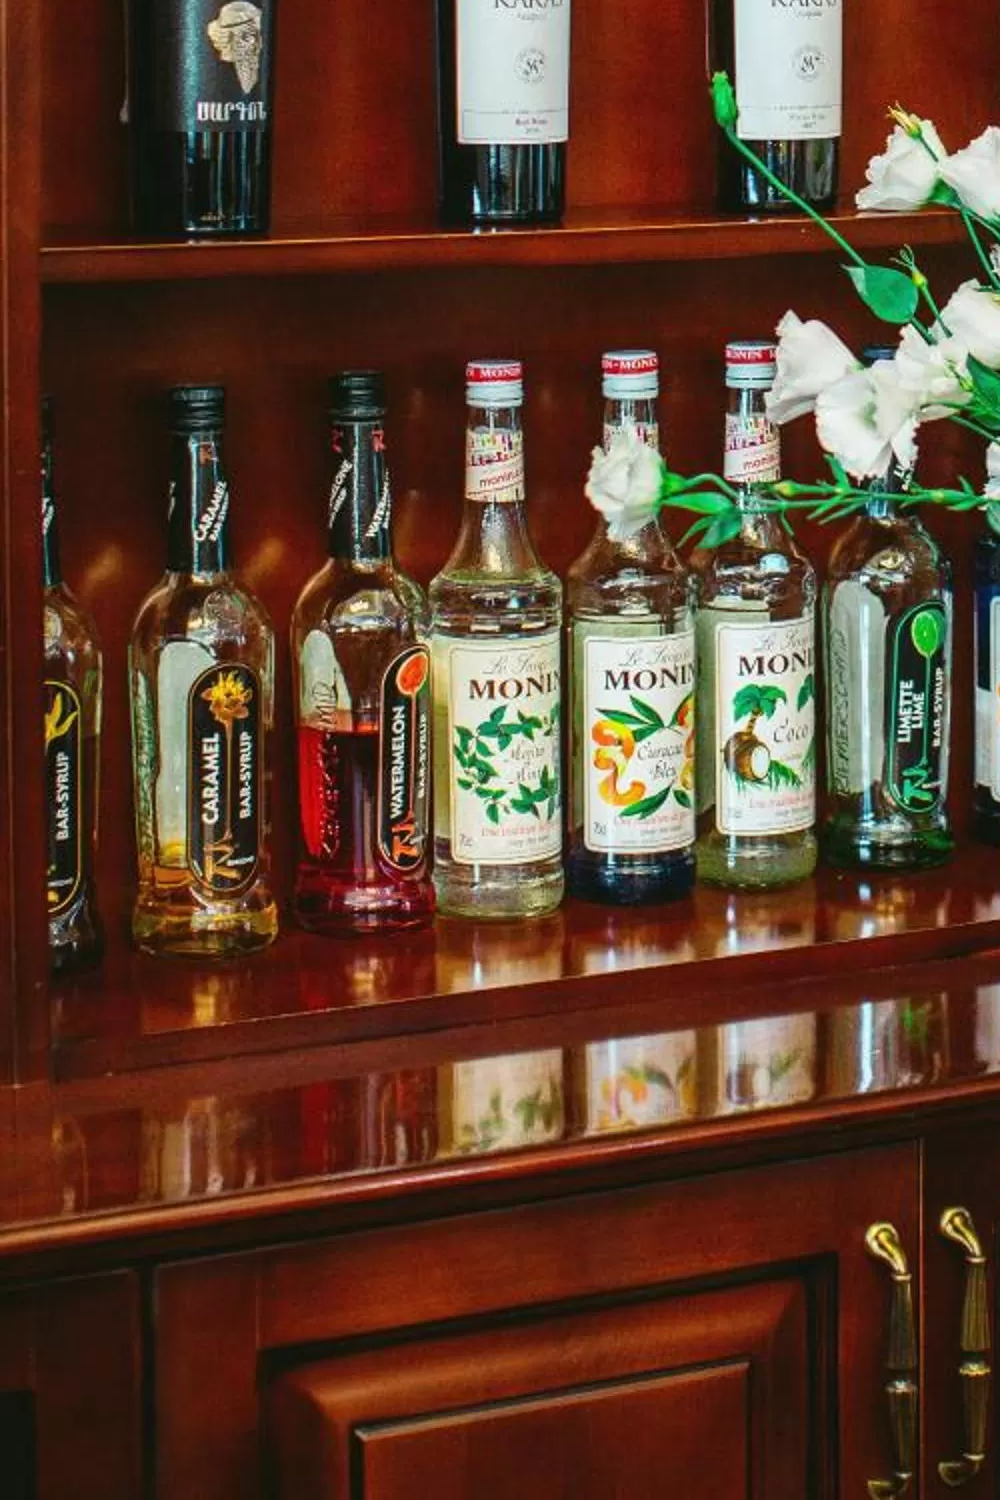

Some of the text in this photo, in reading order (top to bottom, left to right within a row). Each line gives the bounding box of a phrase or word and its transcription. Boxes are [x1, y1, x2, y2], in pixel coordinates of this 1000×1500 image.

[194, 481, 228, 541] CARAMEL
[897, 679, 914, 743] LIMETTE
[911, 691, 925, 729] LIME
[932, 667, 945, 747] BAR-SYRUP
[56, 751, 69, 841] BAR-SYRUP
[202, 731, 221, 826] CARAMEL
[239, 731, 253, 820] BAR-SYRUP
[390, 705, 406, 820] WATERMELON
